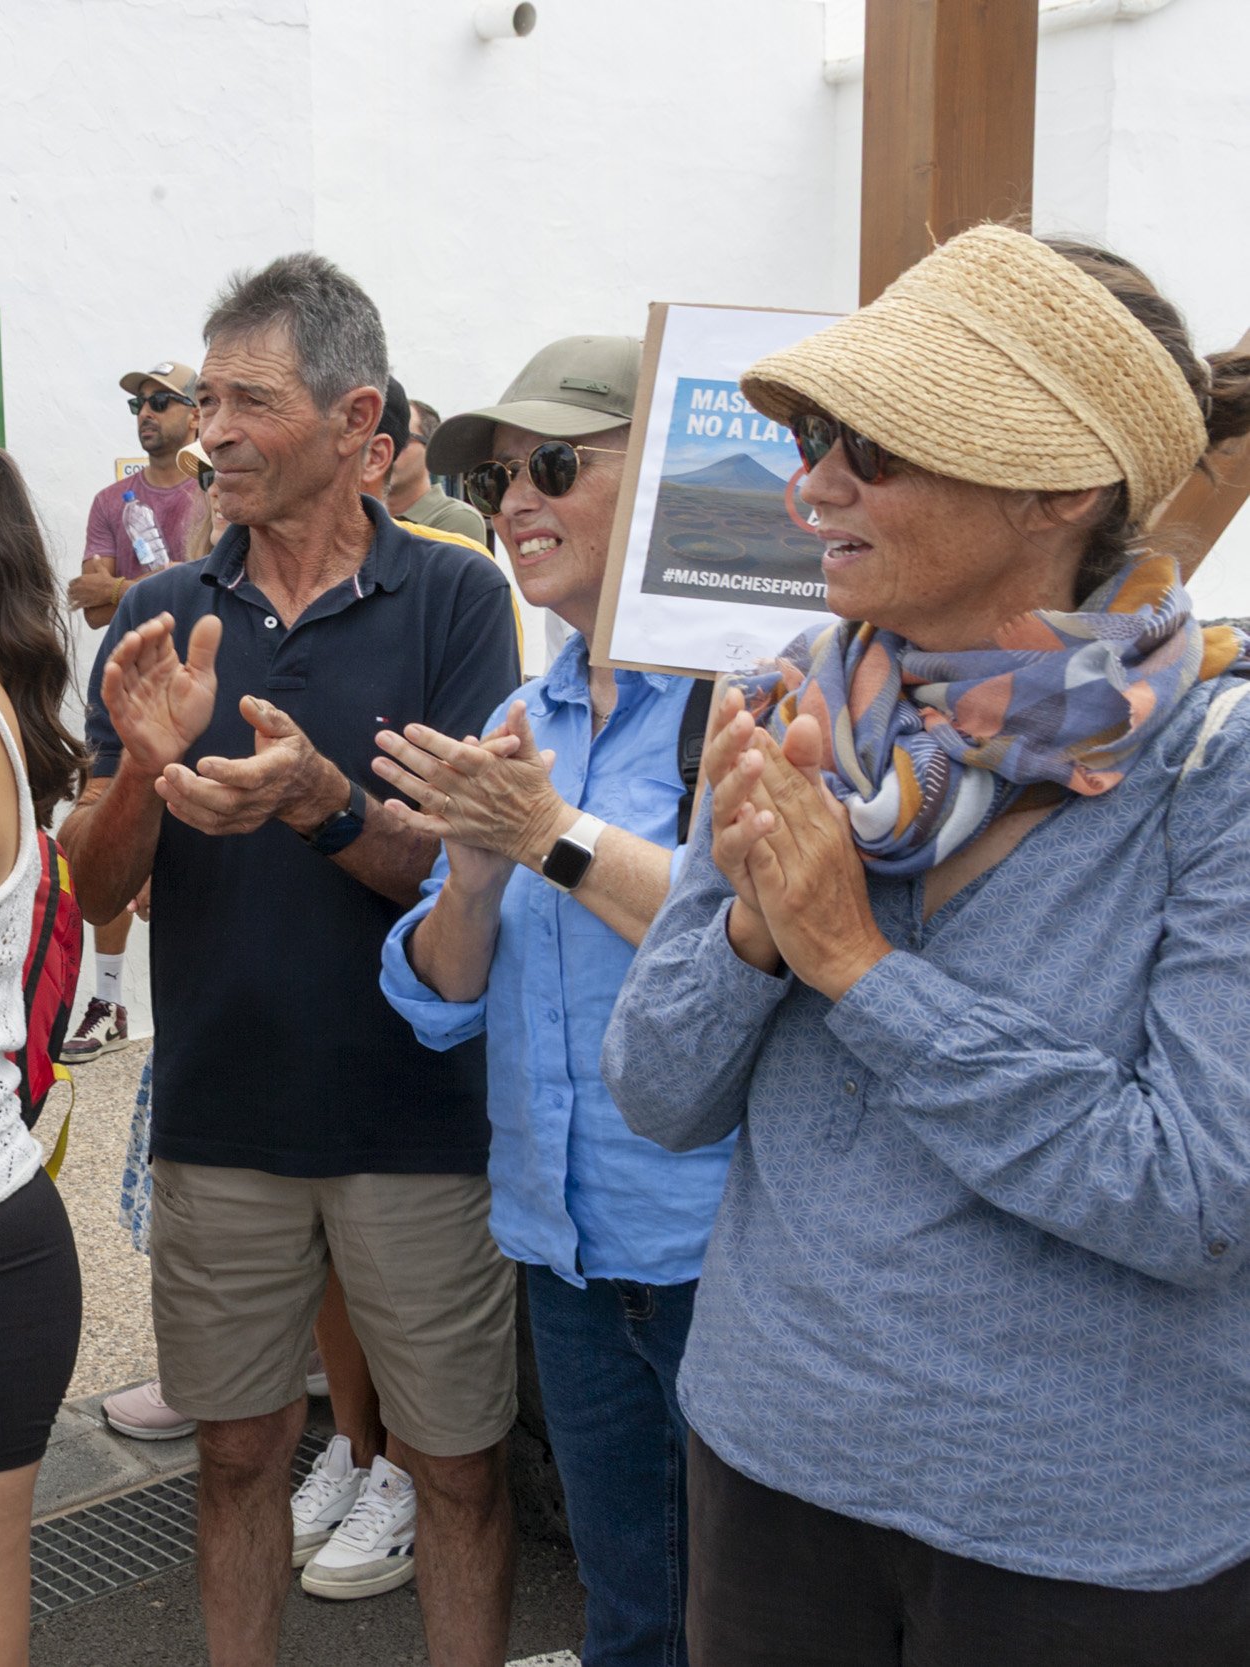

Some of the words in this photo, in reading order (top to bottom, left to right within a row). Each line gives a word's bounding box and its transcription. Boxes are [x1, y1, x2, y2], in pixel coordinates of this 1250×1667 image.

[686, 414, 723, 438] NO
[726, 417, 743, 440] A
[749, 419, 779, 443] LA
[124, 464, 147, 475] CO
